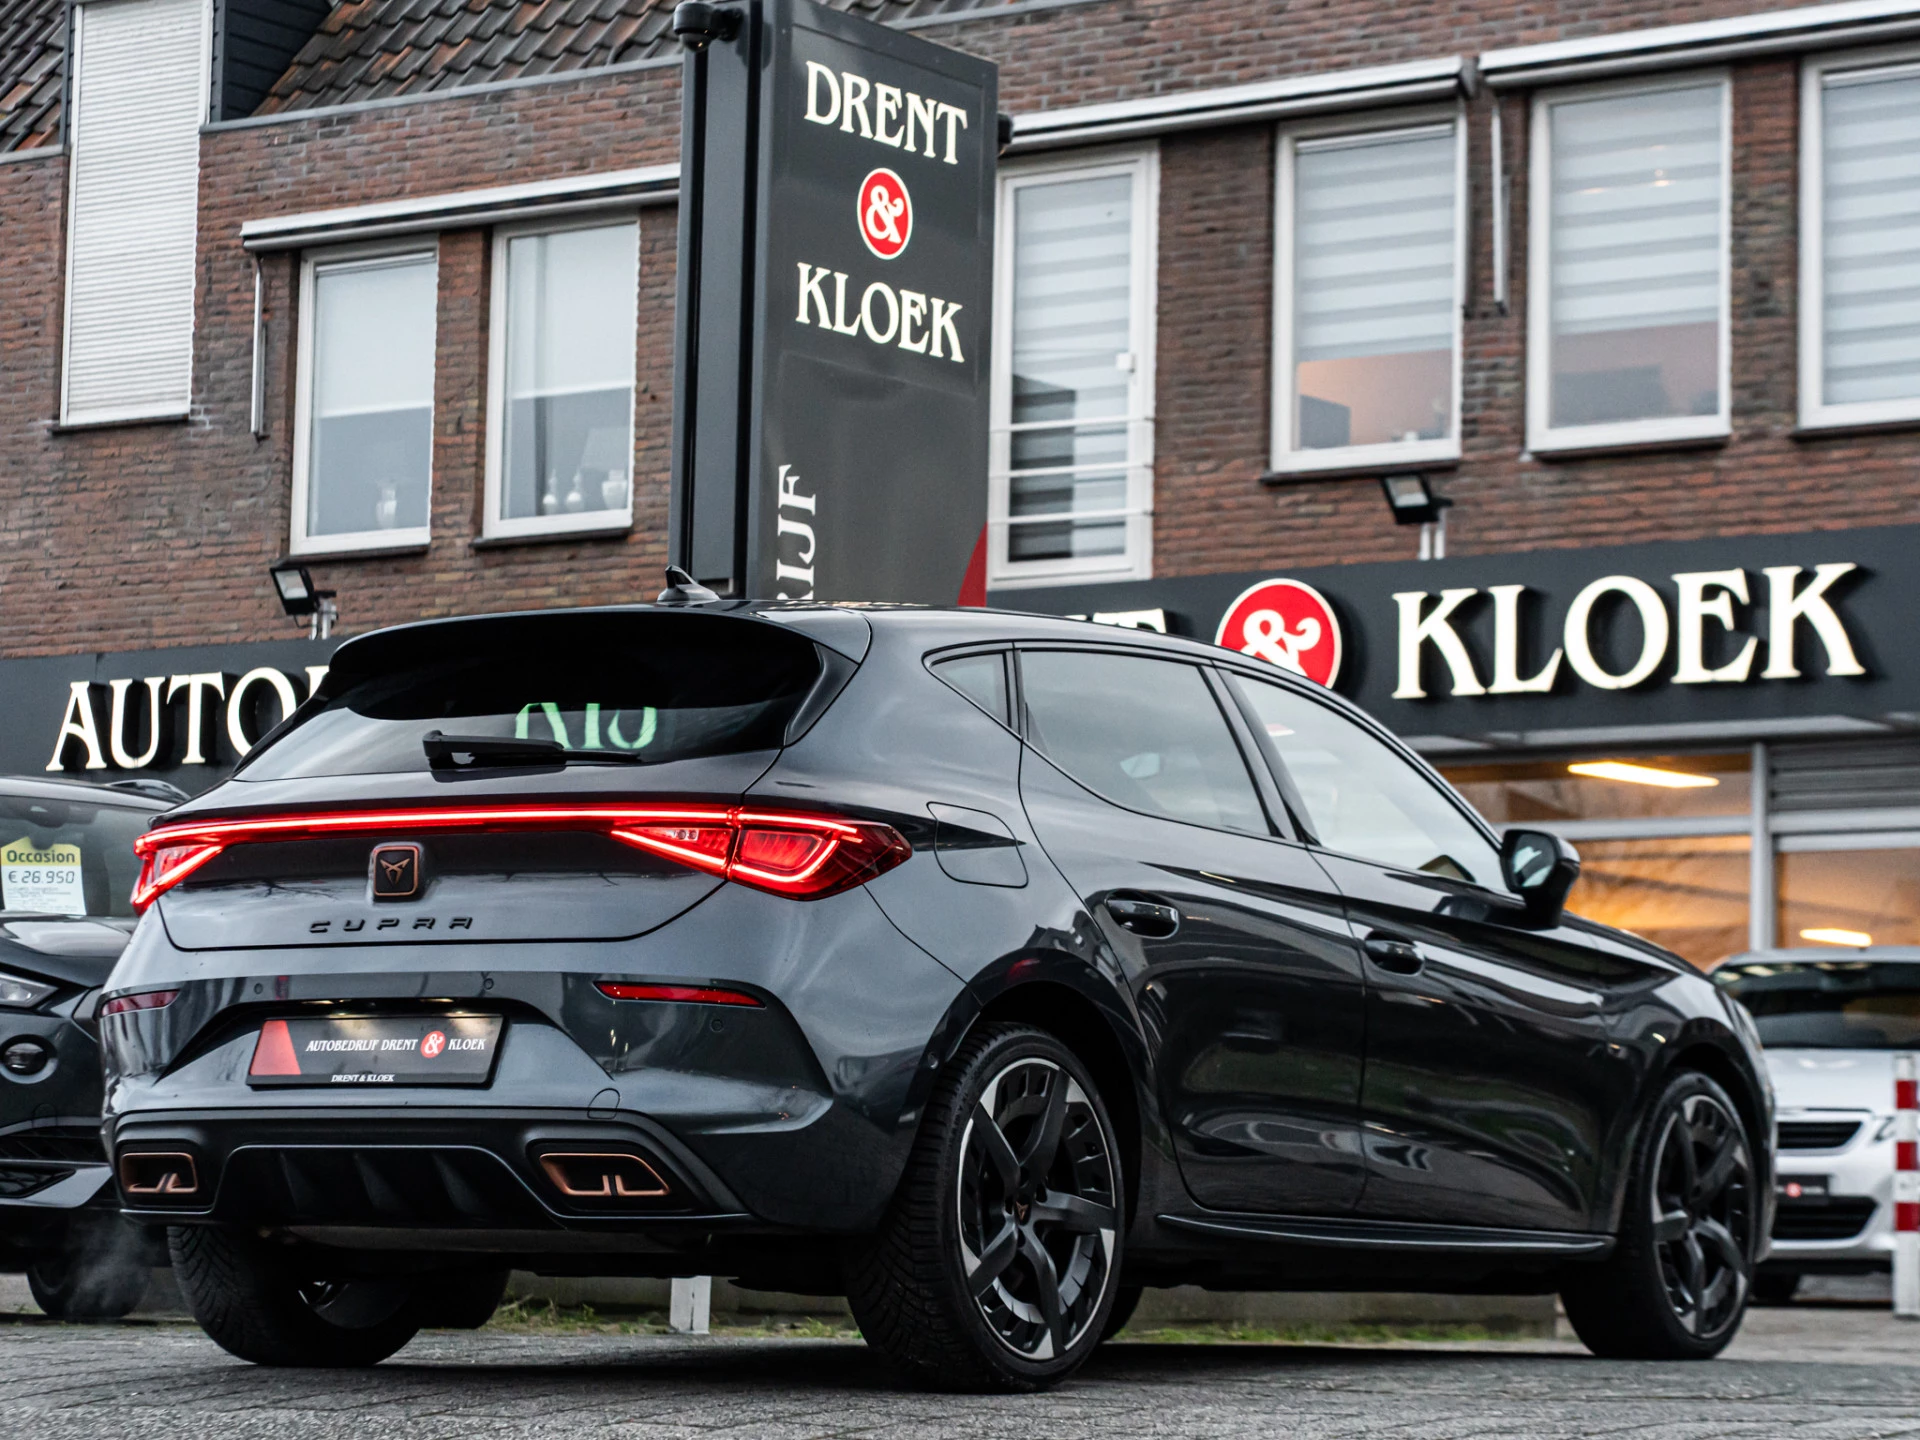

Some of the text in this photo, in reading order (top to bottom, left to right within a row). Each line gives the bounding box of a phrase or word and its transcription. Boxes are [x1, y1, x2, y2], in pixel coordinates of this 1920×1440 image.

[804, 60, 968, 166] DRENT
[795, 262, 965, 363] KLOEK
[775, 463, 817, 600] IJF
[45, 665, 330, 772] AUTO
[1392, 562, 1866, 701] KLOEK
[6, 850, 76, 864] Occasion
[8, 871, 75, 884] € 26.950
[309, 917, 473, 934] CUPRA
[305, 1033, 487, 1055] AUTOBEDRIJF DRENT & KLOEK
[331, 1074, 395, 1083] DRENT & KLOEK
